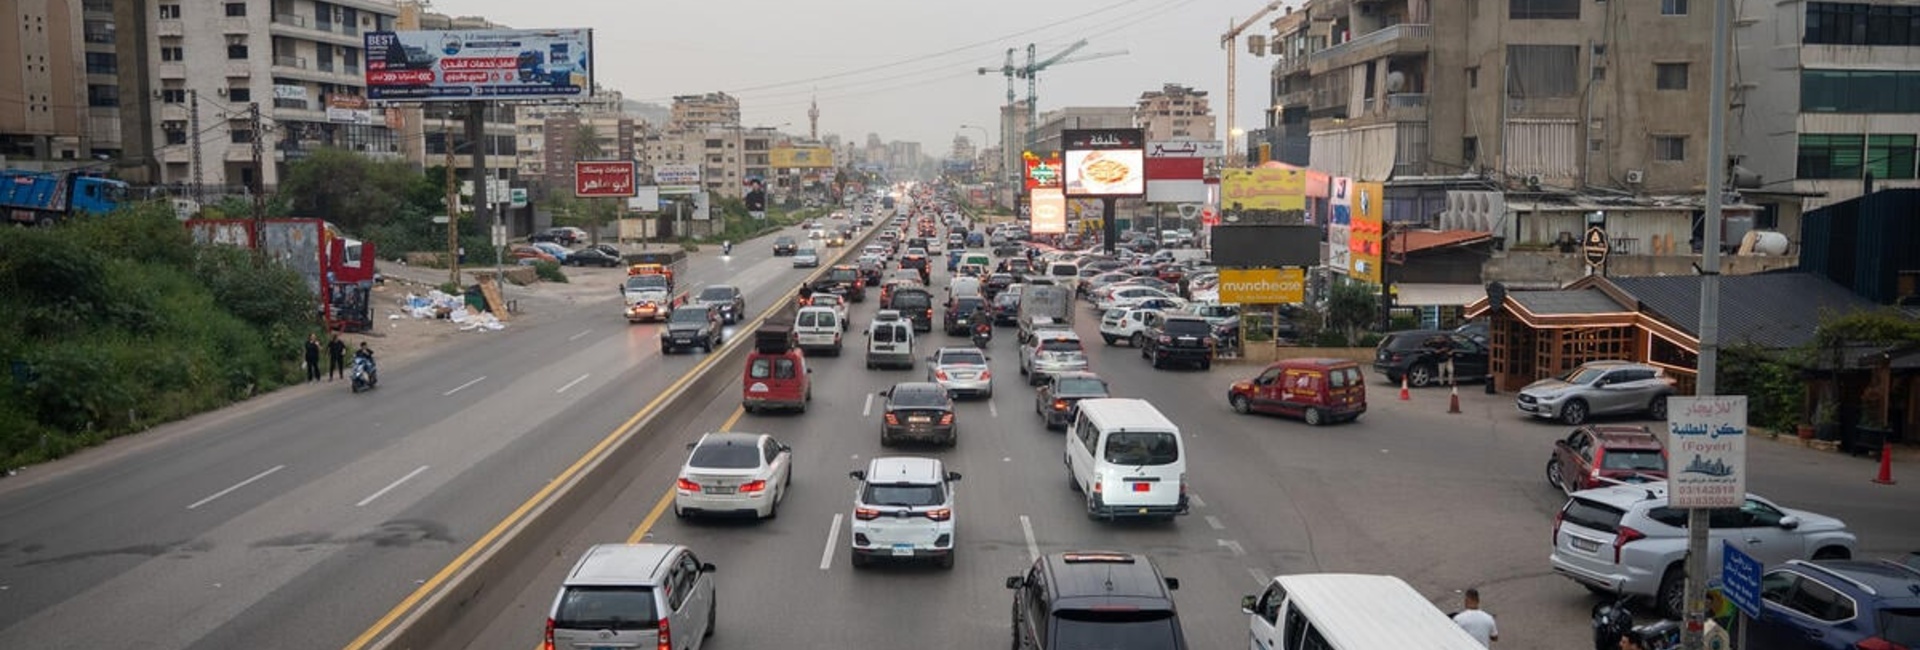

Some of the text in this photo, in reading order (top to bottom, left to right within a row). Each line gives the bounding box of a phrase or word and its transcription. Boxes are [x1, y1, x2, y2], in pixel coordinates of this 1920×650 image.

[367, 35, 395, 45] BEST
[442, 59, 468, 70] الشحن
[469, 59, 495, 68] خدمات
[1089, 134, 1122, 145] خليفة
[1150, 141, 1198, 156] بشير
[612, 174, 630, 192] أبو
[1222, 279, 1301, 292] munchease
[1671, 422, 1744, 439] سكن للطلبة
[1681, 441, 1733, 453] (Foyer)
